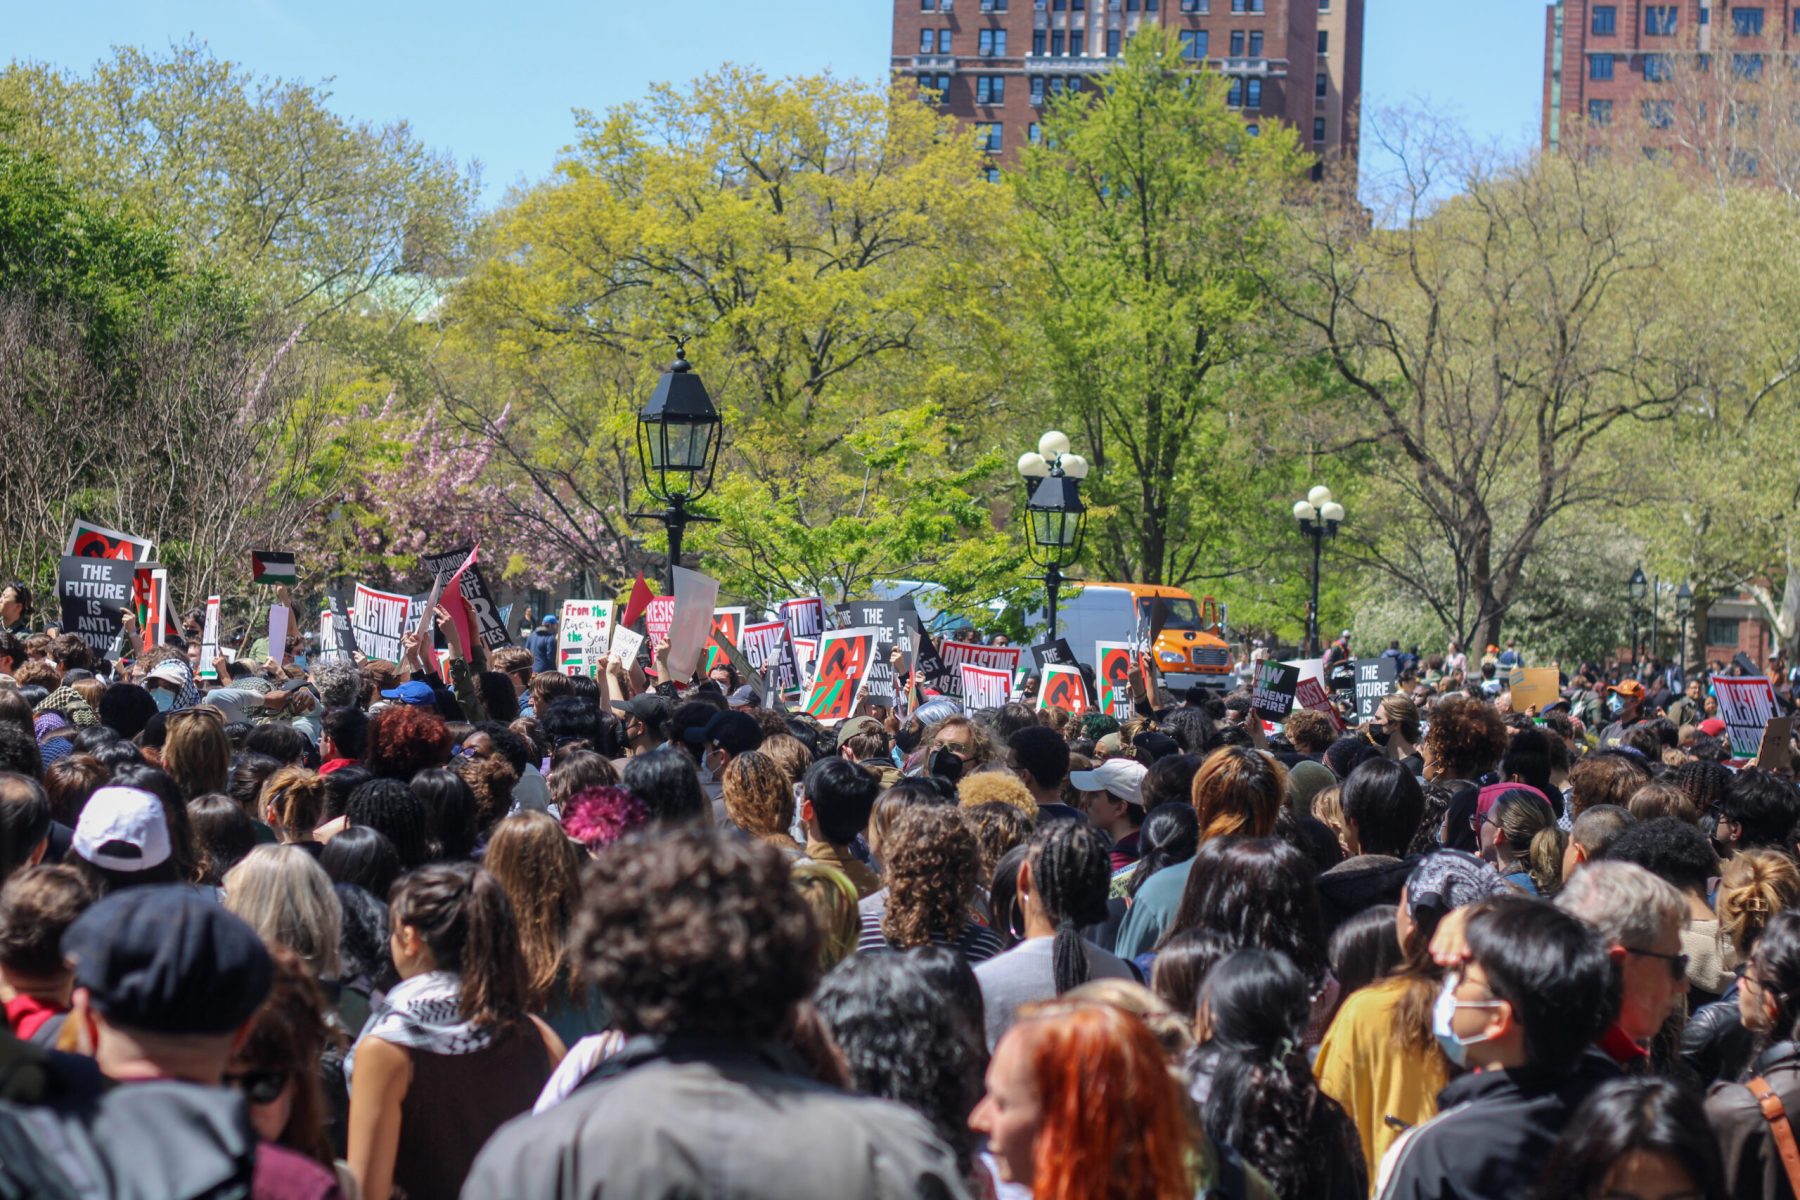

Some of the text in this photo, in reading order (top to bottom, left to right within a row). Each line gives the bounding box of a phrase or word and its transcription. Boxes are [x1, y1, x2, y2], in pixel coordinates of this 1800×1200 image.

[81, 564, 112, 581] THE
[65, 581, 126, 599] FUTURE
[87, 600, 101, 615] IS
[565, 604, 607, 617] From the
[647, 600, 674, 622] RESIS
[78, 616, 115, 632] ANTI-
[863, 608, 884, 625] THE
[596, 620, 605, 630] to
[82, 633, 121, 652] ONIST
[567, 631, 582, 642] the
[943, 645, 1017, 676] PALESTINE
[1042, 648, 1060, 663] THE
[1361, 665, 1378, 680] THE
[1112, 686, 1126, 701] HE
[1362, 699, 1372, 714] IS
